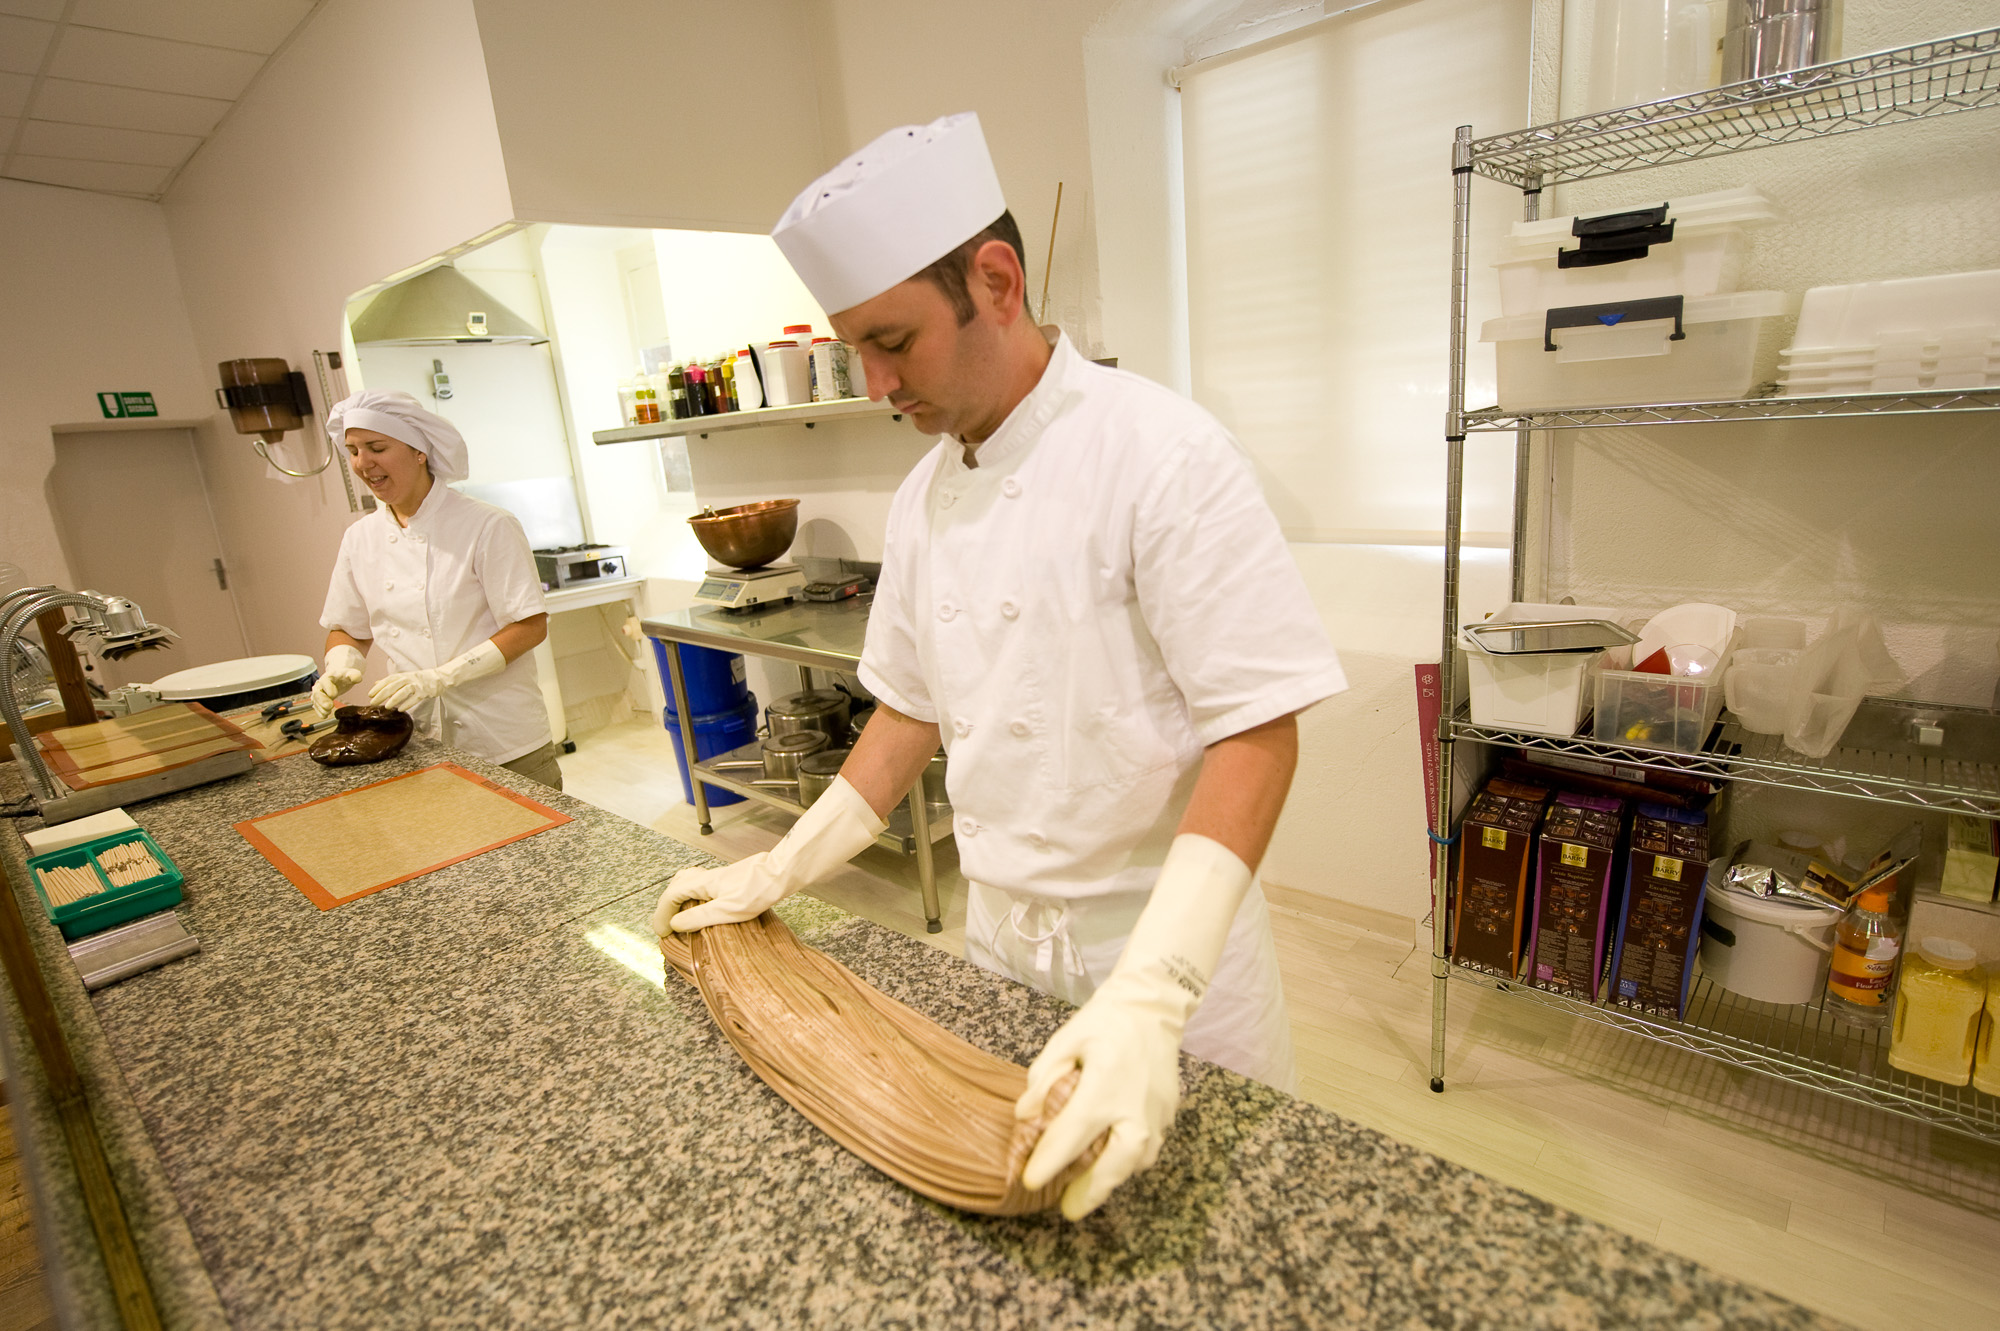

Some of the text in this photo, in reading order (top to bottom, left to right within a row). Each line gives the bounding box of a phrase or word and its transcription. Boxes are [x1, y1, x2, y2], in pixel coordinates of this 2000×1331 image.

[1425, 742, 1433, 762] FACES
[1483, 836, 1504, 845] BARRY
[1562, 853, 1586, 862] BARRY
[1654, 866, 1681, 876] BARRY
